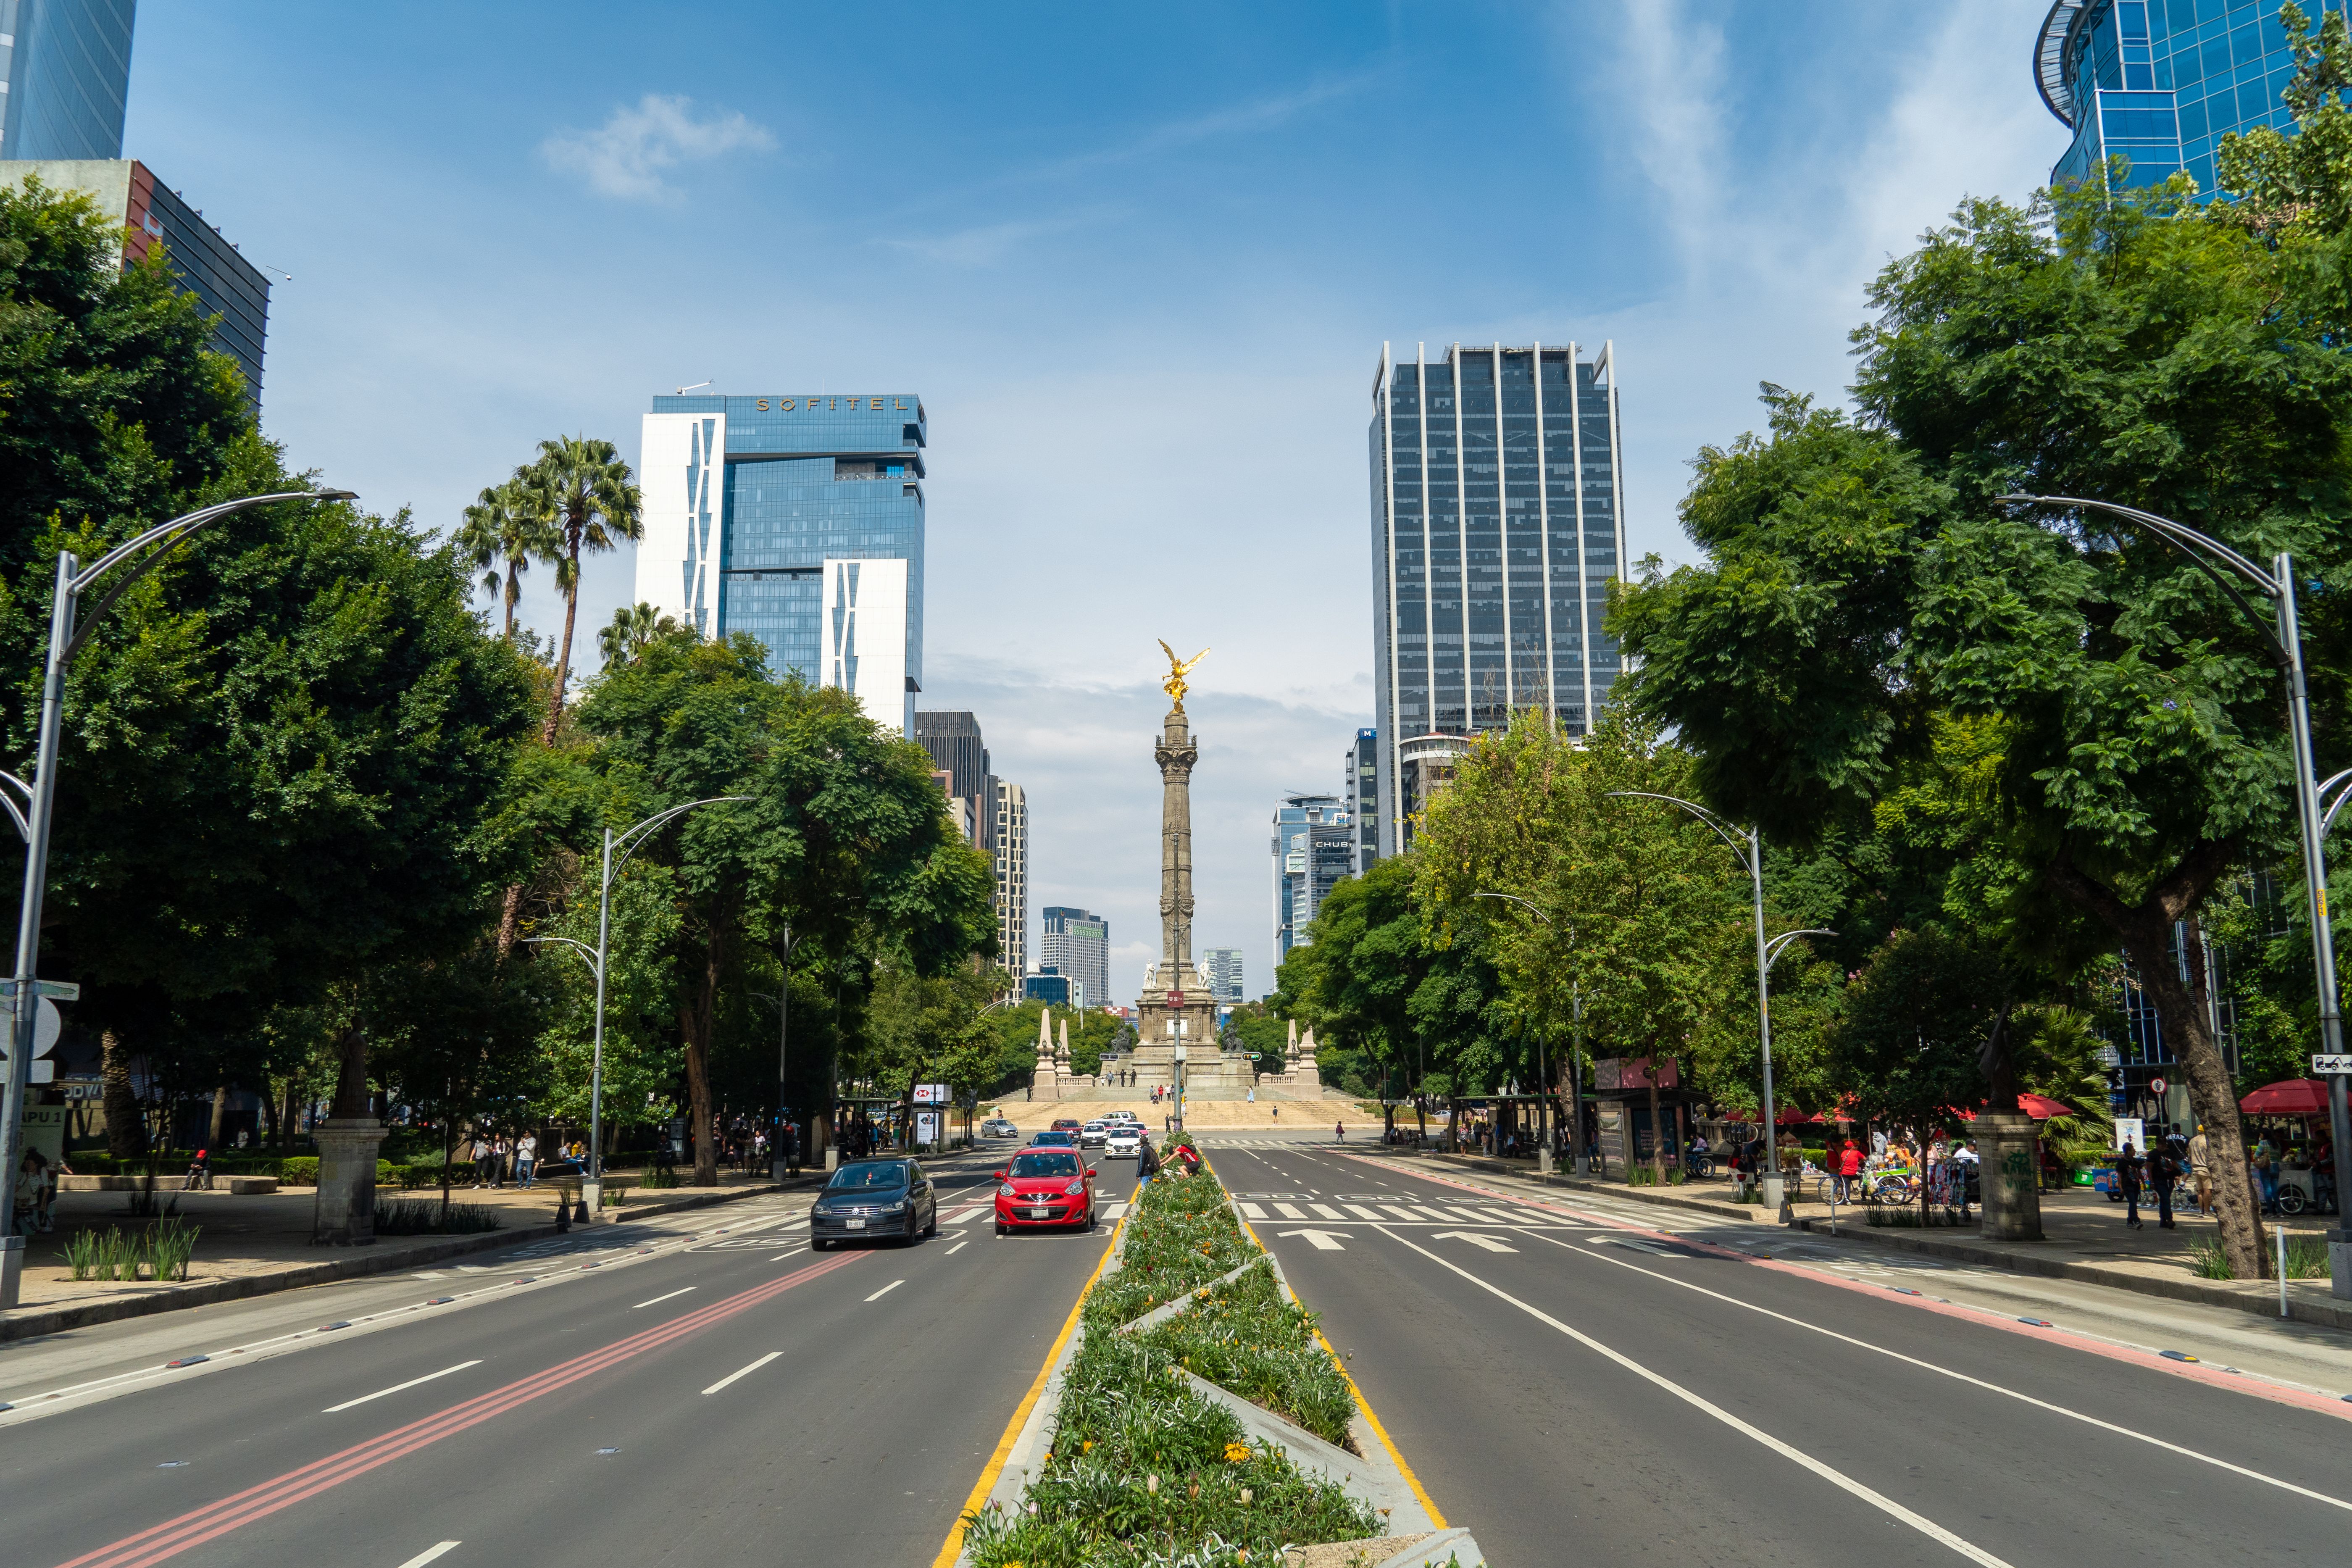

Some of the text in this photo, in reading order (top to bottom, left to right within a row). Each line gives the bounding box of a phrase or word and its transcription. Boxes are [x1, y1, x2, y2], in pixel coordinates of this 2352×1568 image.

[756, 398, 908, 411] SOFITEL
[1073, 929, 1103, 938] 5555352075
[54, 1112, 61, 1123] 1
